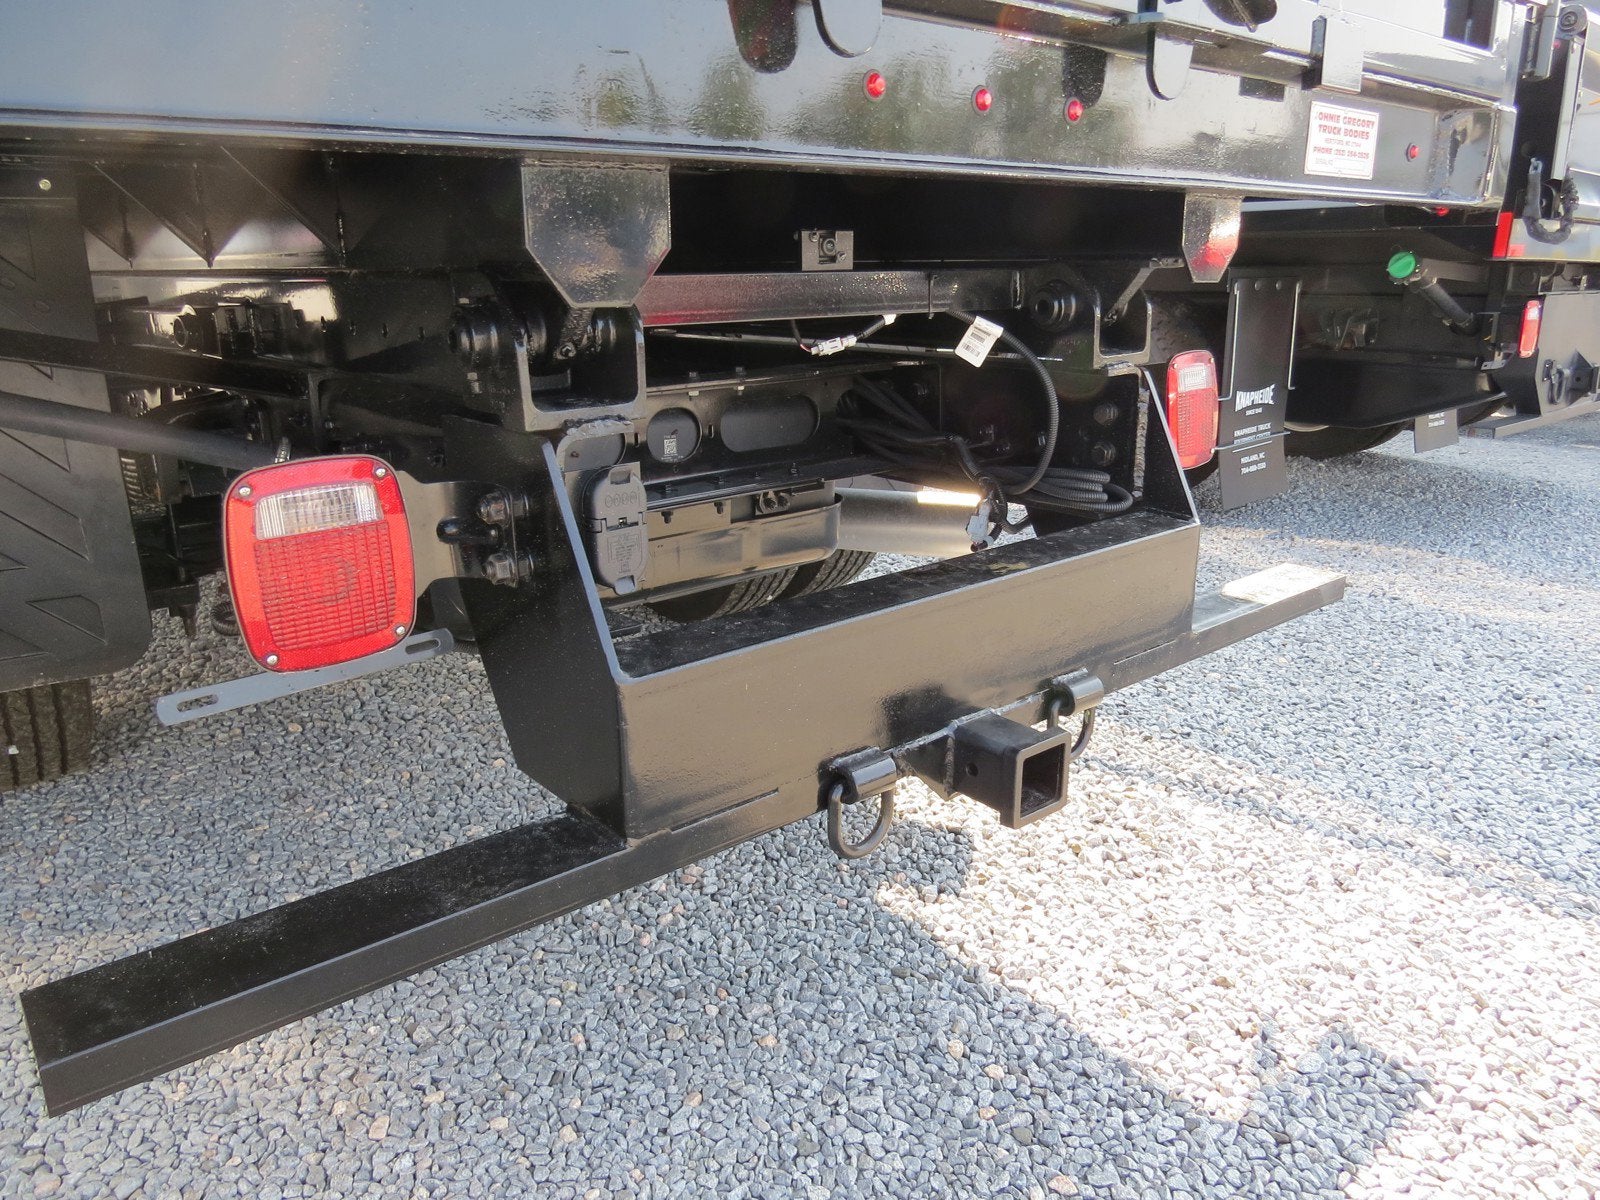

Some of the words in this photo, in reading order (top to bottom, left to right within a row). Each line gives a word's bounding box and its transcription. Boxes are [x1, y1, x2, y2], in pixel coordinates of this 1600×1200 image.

[1343, 116, 1375, 129] GREGORY
[1318, 124, 1341, 136] TRUCK
[1344, 128, 1369, 140] BODIES
[1235, 383, 1276, 412] KNAPHEIDE
[1258, 422, 1271, 431] TRUCK
